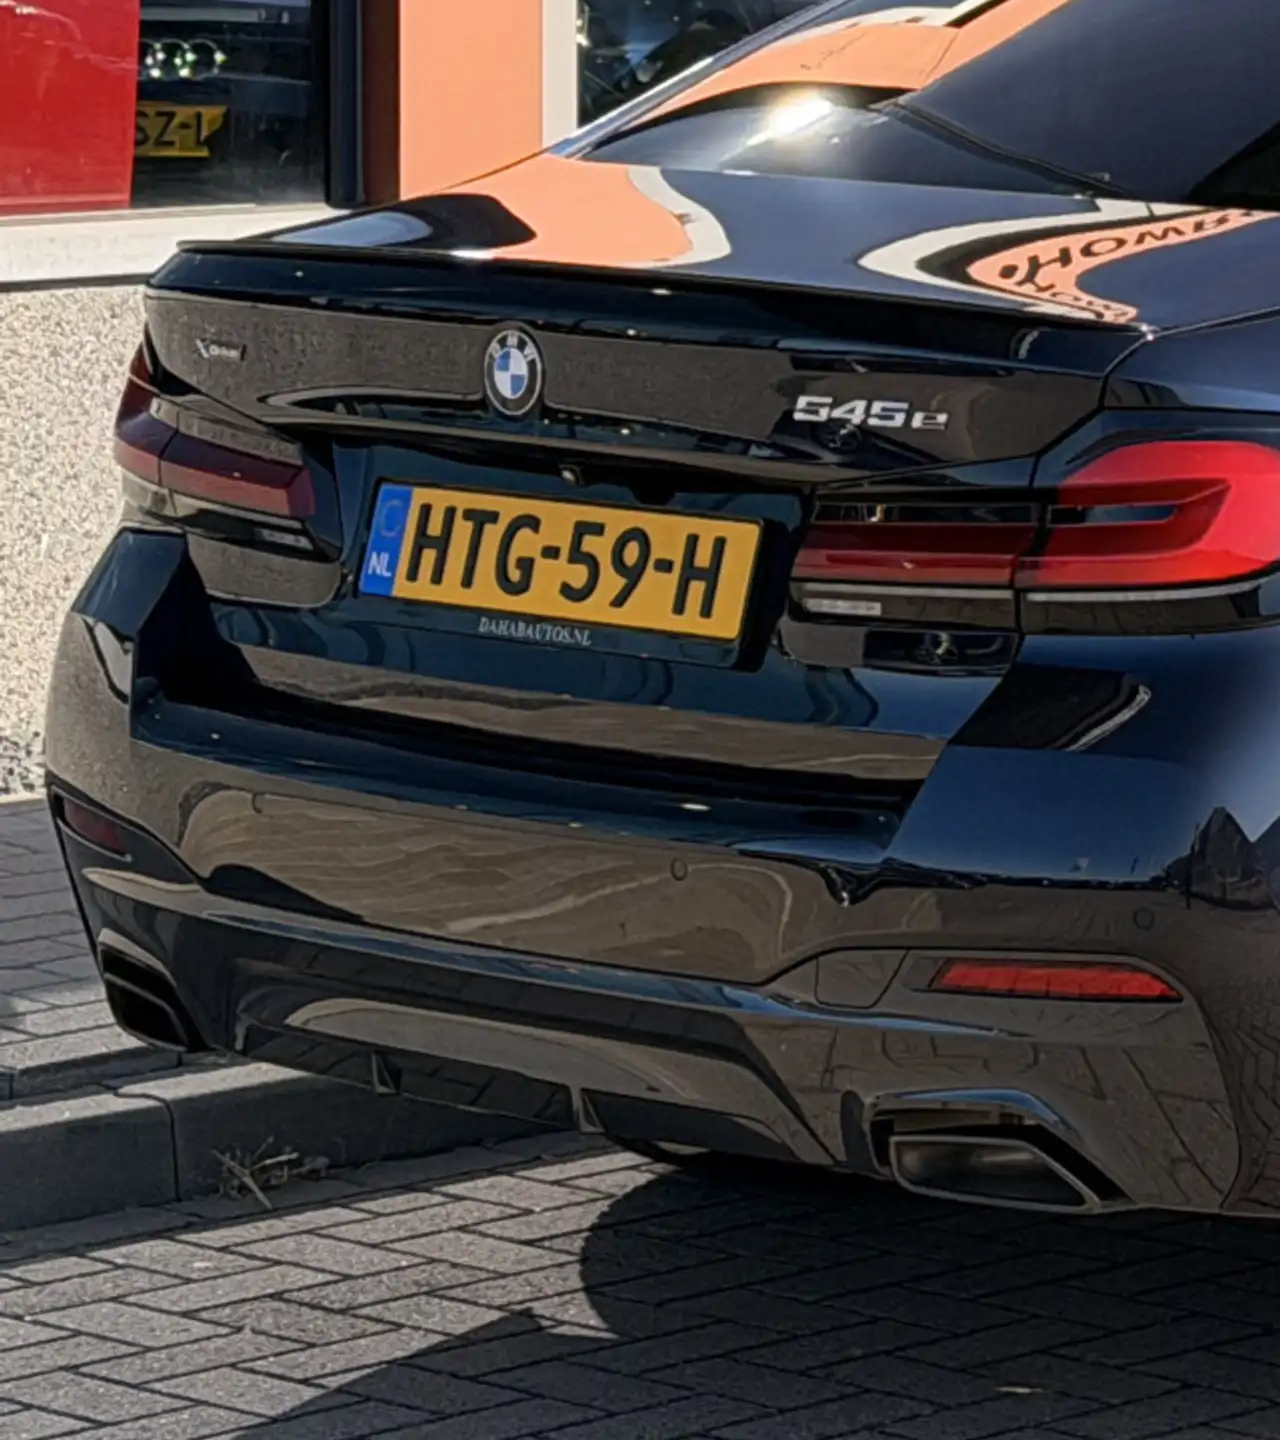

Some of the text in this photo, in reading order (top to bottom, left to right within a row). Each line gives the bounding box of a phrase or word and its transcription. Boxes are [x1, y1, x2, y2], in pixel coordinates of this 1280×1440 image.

[793, 396, 949, 430] 545e
[367, 503, 727, 619] NL HTG-59-H
